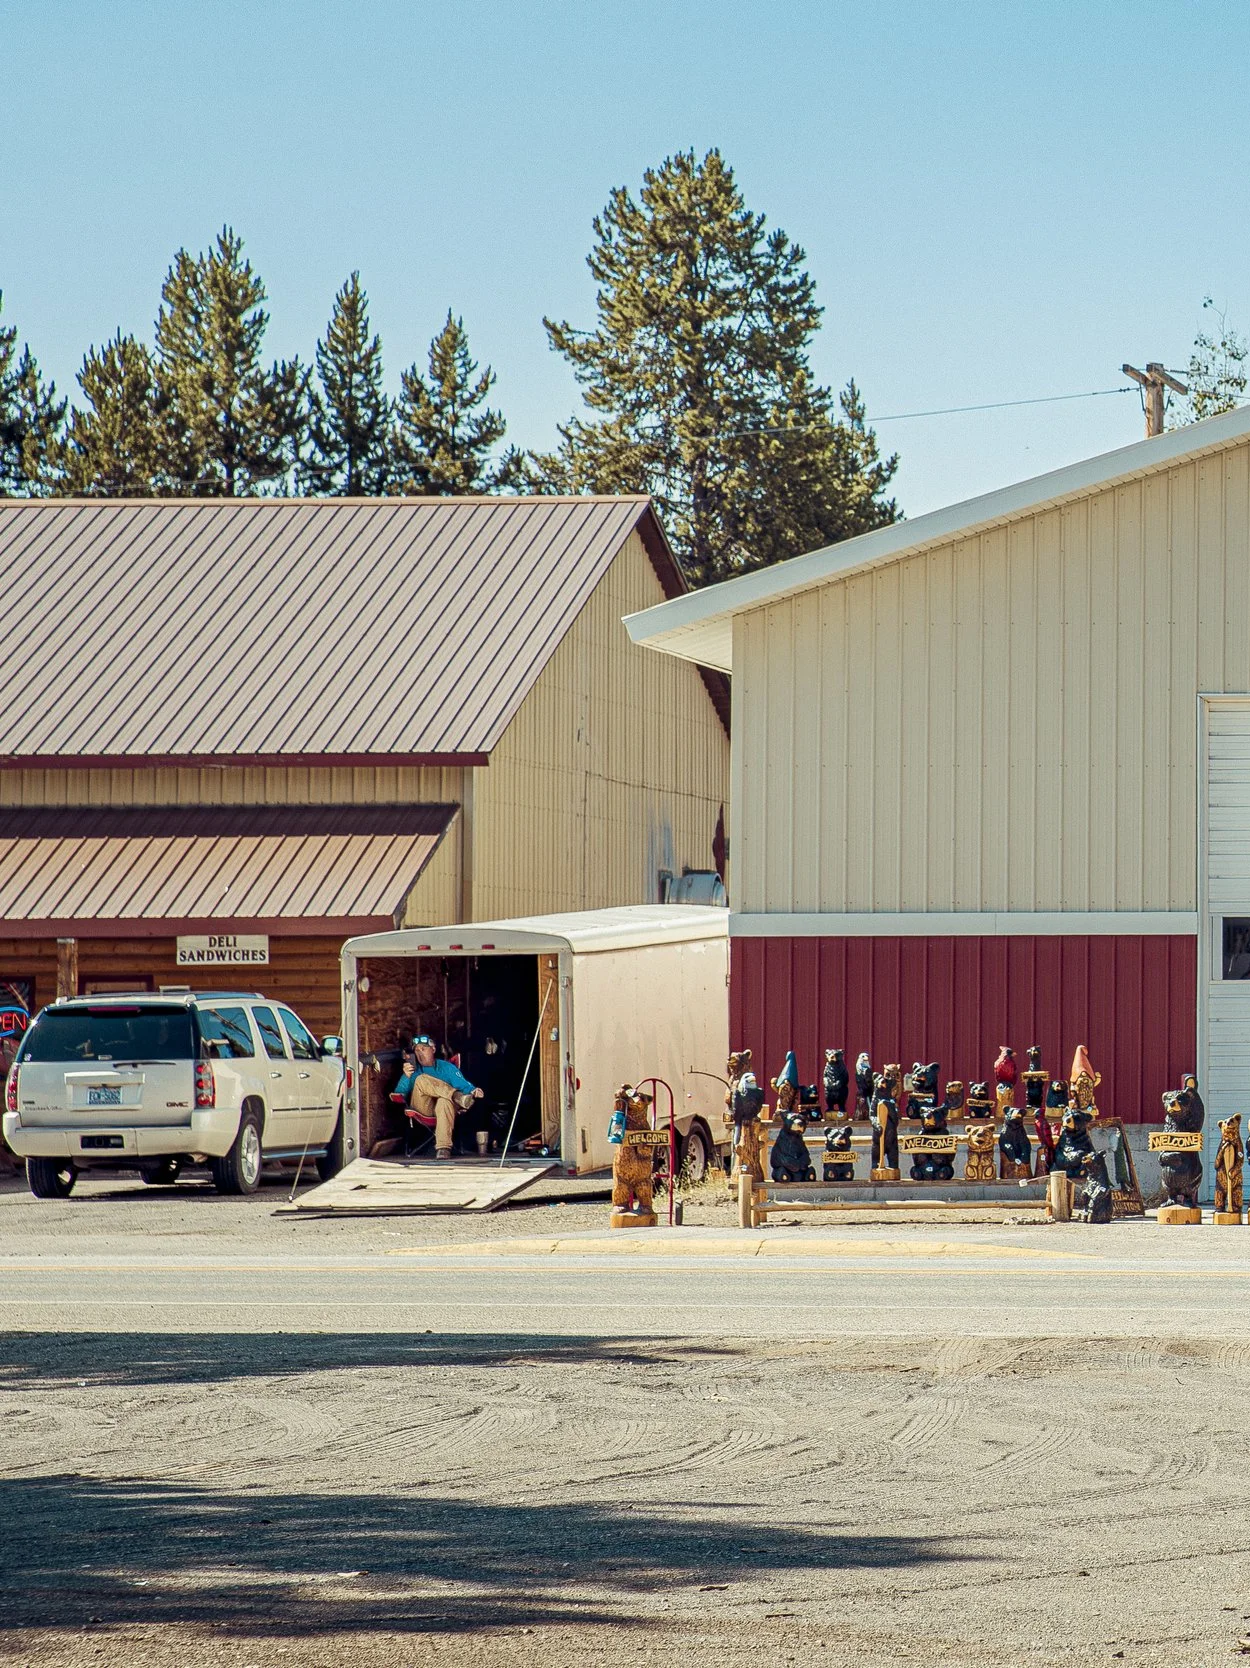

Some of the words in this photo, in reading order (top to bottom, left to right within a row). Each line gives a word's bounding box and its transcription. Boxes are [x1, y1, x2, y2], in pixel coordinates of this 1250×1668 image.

[208, 936, 237, 948] DELI
[180, 950, 266, 962] SANDWICHES
[0, 1012, 26, 1031] EN
[628, 1133, 669, 1144] WELCOME
[904, 1137, 954, 1149] WELCOME
[1151, 1135, 1199, 1148] WELCOME
